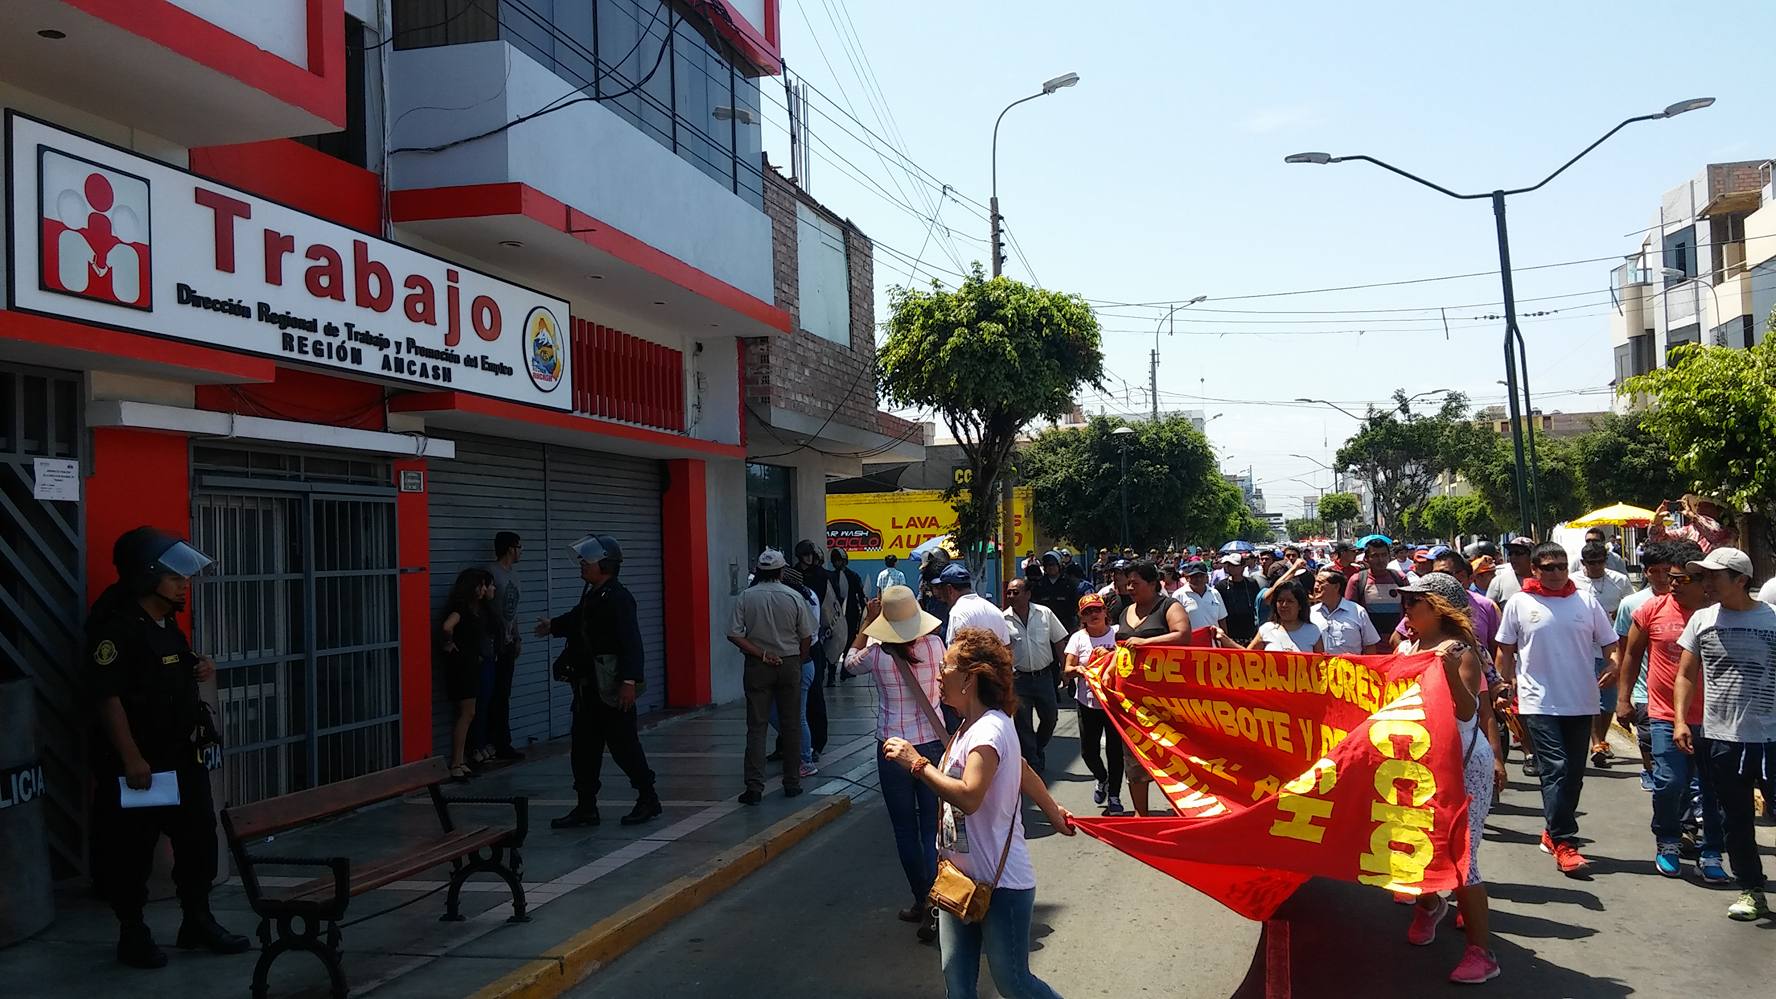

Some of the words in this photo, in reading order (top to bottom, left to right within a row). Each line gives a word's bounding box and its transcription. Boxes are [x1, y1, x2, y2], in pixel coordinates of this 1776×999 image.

[194, 186, 503, 348] Trabajo
[176, 282, 252, 319] Dirección
[257, 301, 318, 331] Regional
[323, 321, 340, 338] de
[344, 322, 391, 351] Trabajo
[394, 339, 403, 355] y
[406, 337, 461, 365] Promoción
[463, 354, 478, 369] del
[481, 355, 514, 377] Empleo
[281, 332, 363, 365] REGIÓN
[381, 354, 452, 383] ANCASH
[891, 515, 940, 529] LAVA
[1143, 650, 1186, 683] DE
[1191, 650, 1384, 715] TRABAJADORES
[1141, 695, 1293, 754] CHIMBOTE
[1297, 717, 1314, 762] Y
